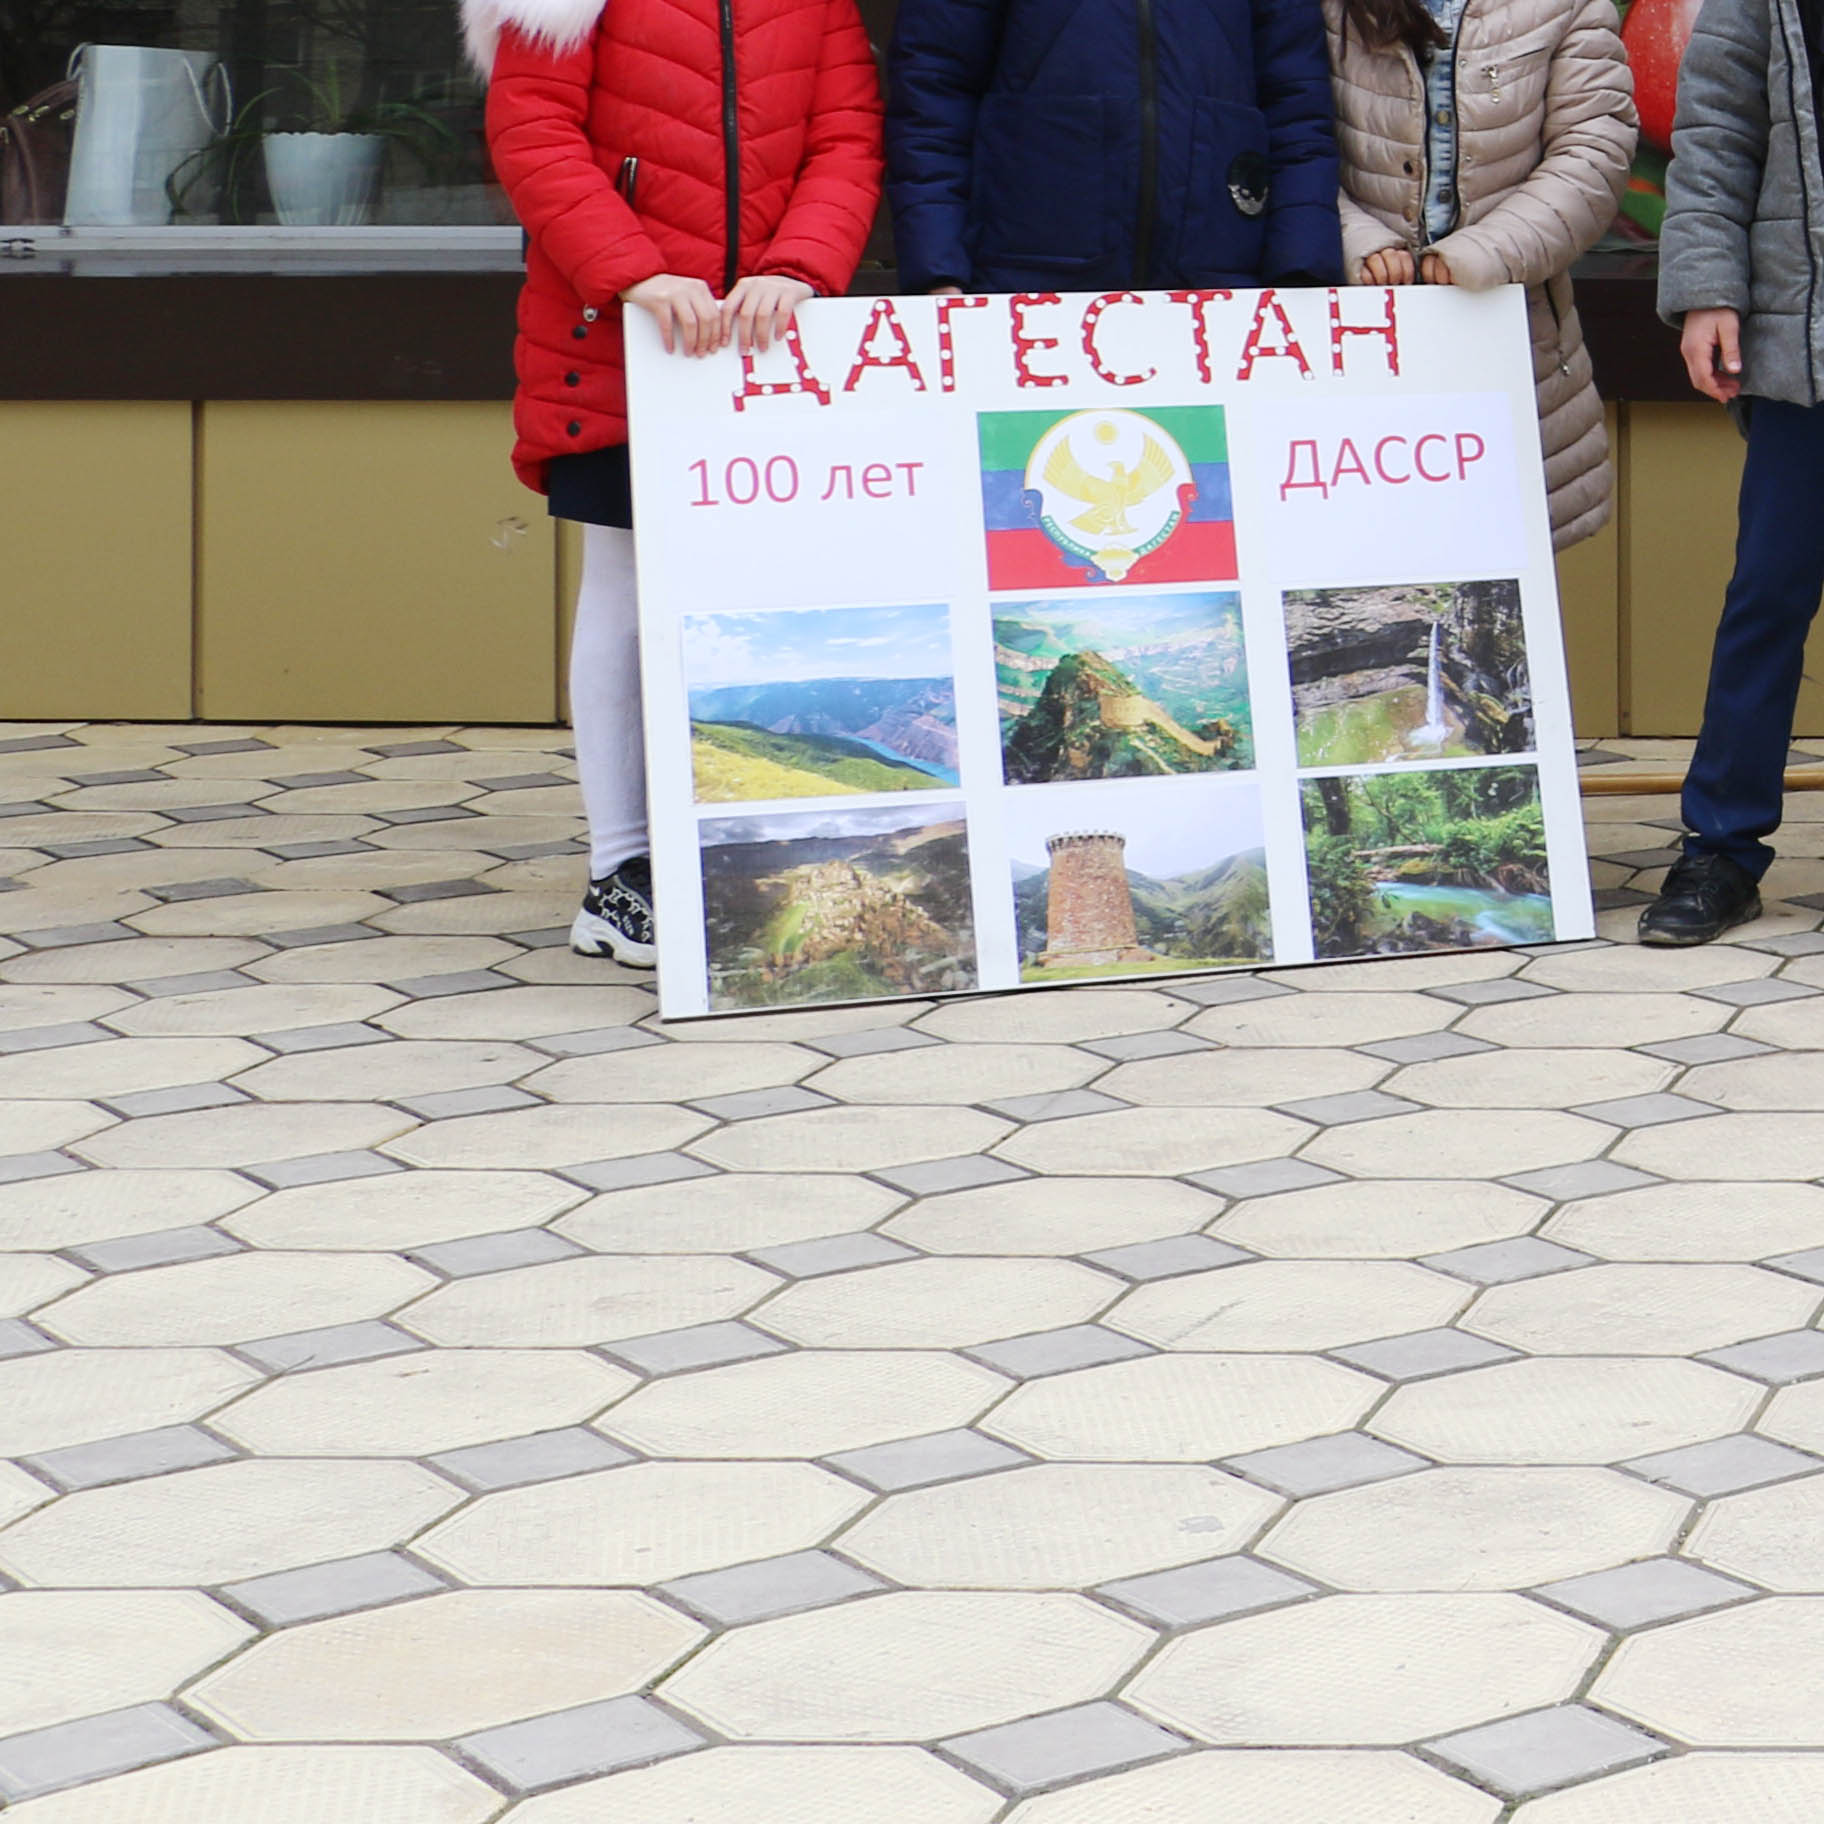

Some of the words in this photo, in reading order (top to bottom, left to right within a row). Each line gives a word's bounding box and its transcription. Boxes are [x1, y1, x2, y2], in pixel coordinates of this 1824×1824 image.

[732, 287, 1400, 412] ДАГЕСТАН
[688, 455, 800, 507] 100
[820, 461, 925, 502] лет
[1279, 433, 1486, 502] ДАССР
